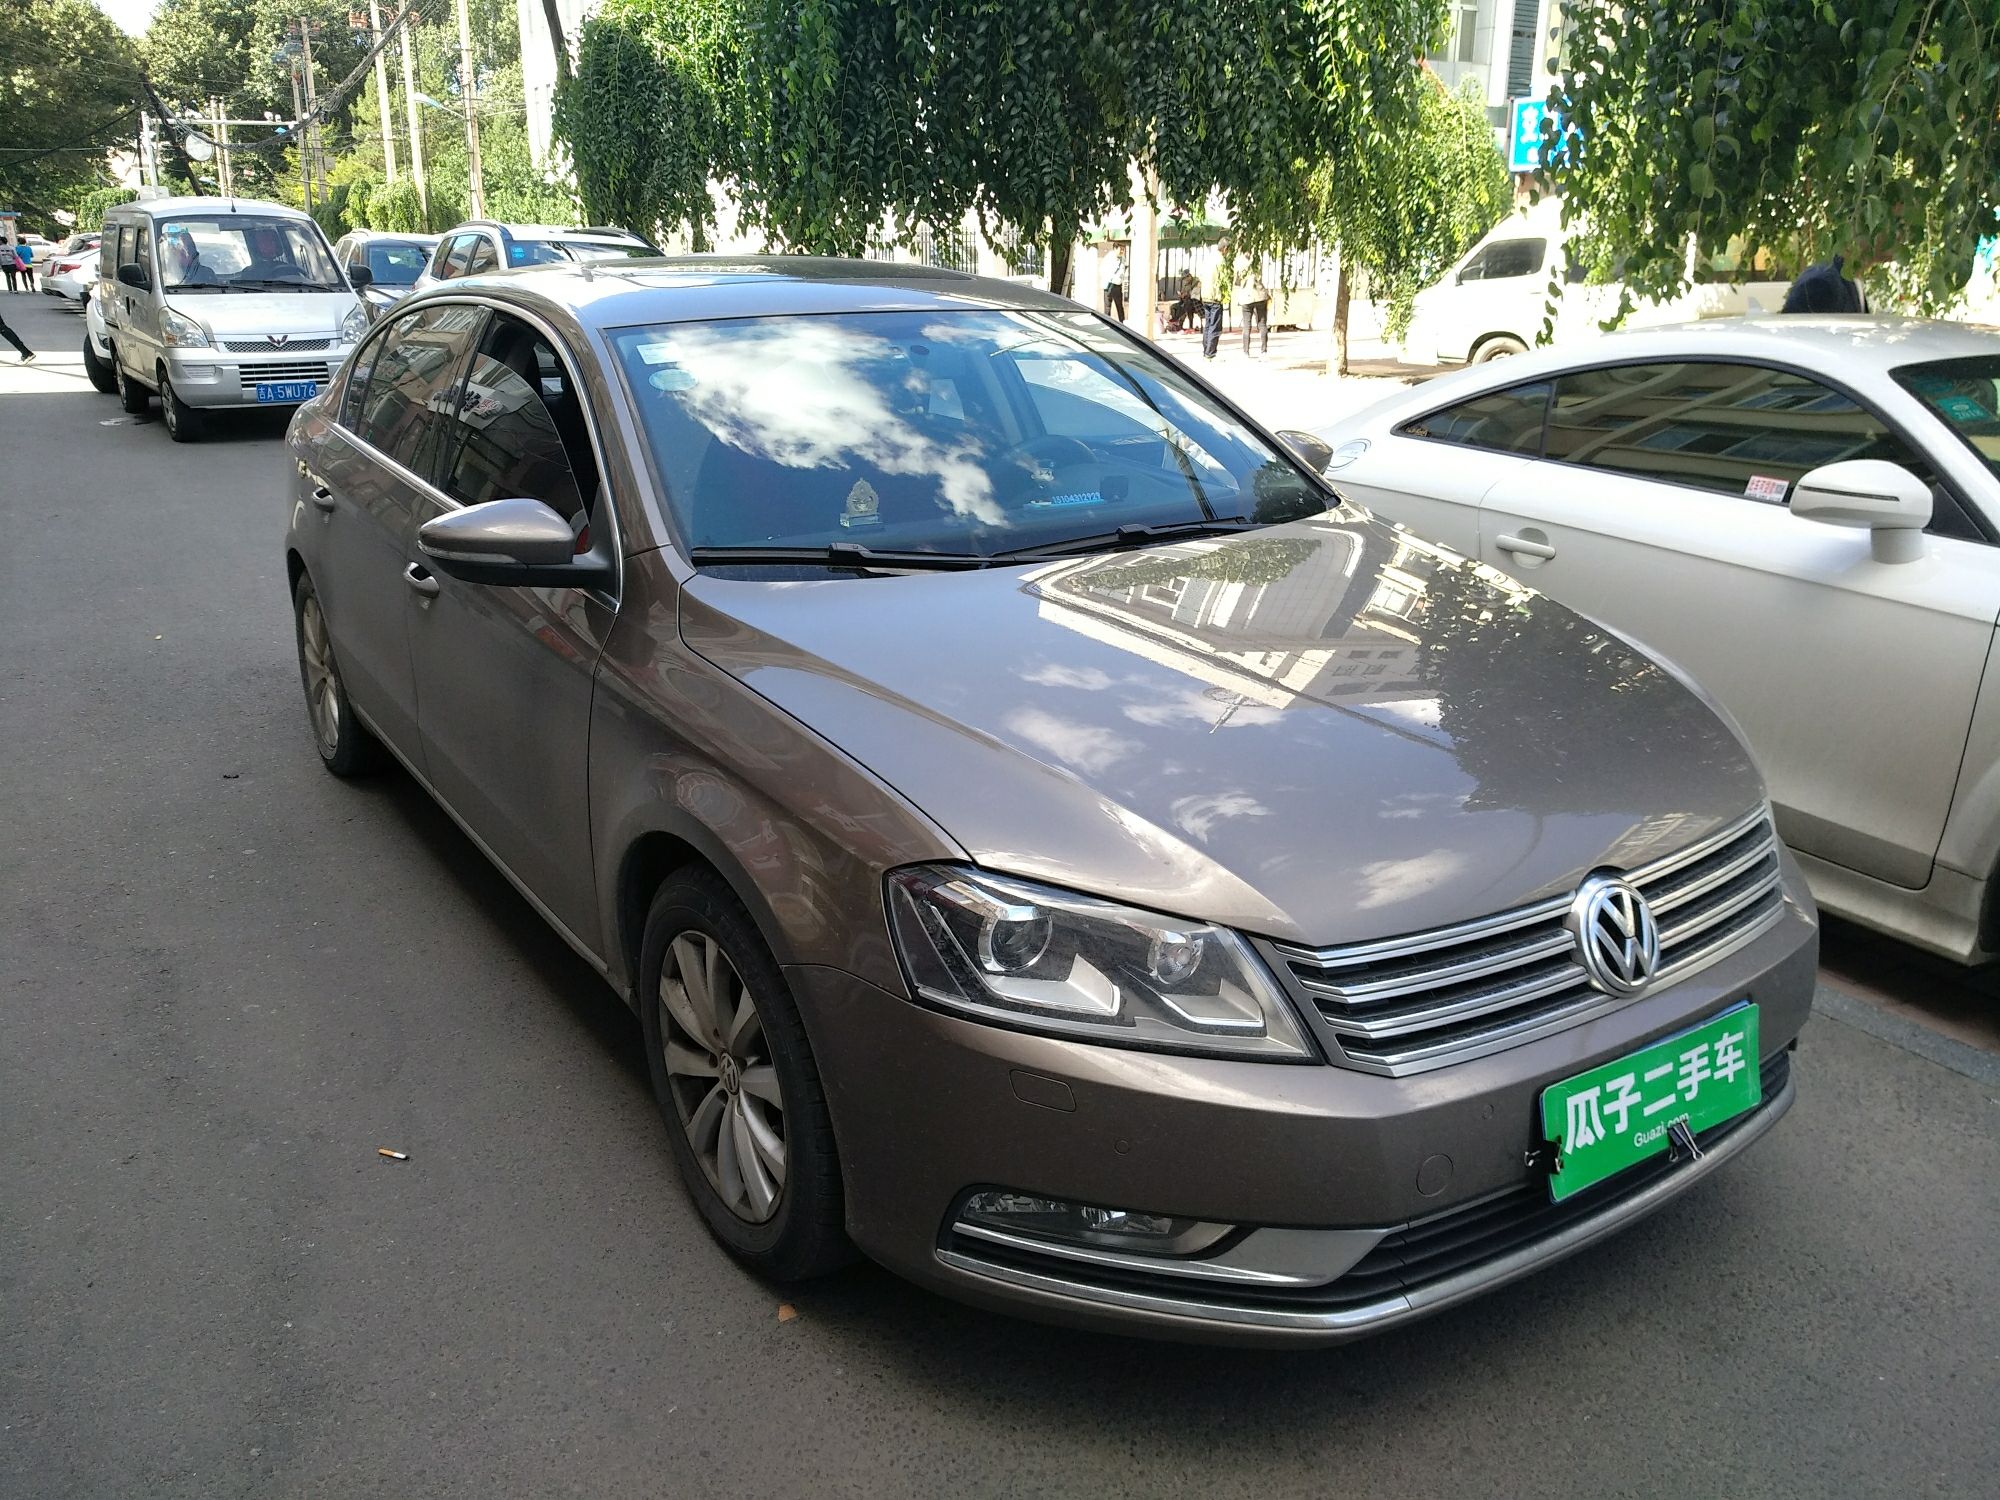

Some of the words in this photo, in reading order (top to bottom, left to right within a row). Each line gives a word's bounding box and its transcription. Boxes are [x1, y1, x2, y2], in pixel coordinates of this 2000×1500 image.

[1564, 1031, 1746, 1155] 瓜子二手车
